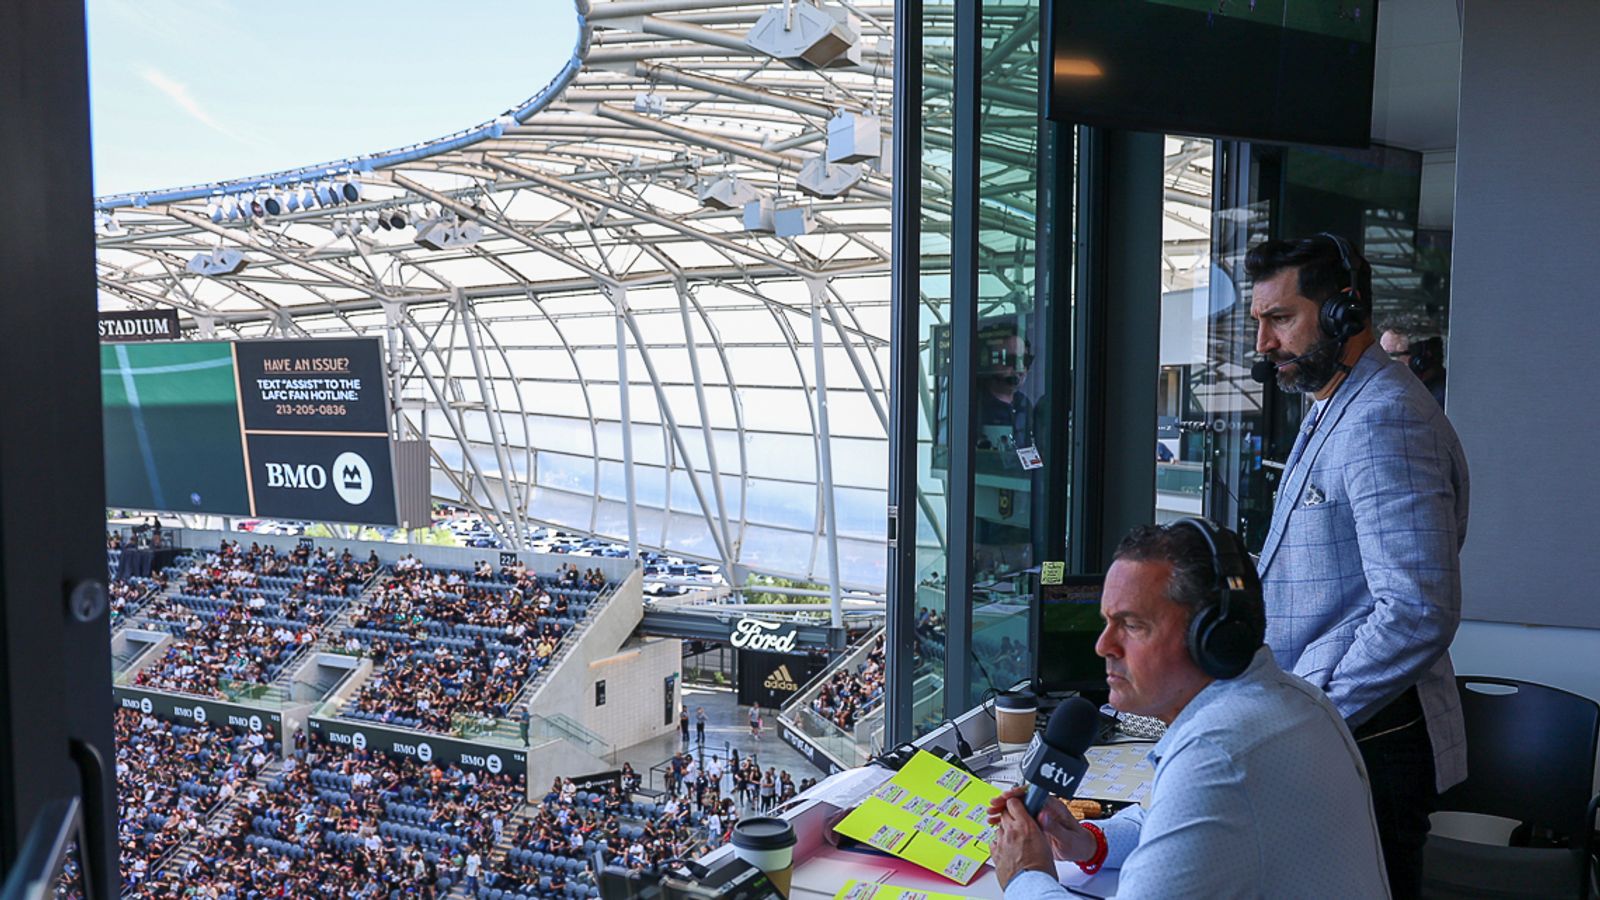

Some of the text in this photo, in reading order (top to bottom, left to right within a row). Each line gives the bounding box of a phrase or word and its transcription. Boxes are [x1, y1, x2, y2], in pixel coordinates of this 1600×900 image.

[98, 318, 170, 336] STADIUM
[263, 357, 350, 372] HAVE AN ISSUE?
[257, 379, 361, 390] TEXT "ASSIST" TO THE
[262, 390, 359, 401] LAFC FAN HOTLINE:
[275, 404, 347, 416] 213-205-0836
[265, 462, 327, 490] BMO
[730, 618, 797, 652] Ford
[763, 680, 798, 691] adidas
[122, 698, 140, 709] BMO
[174, 706, 193, 718] BMO
[228, 715, 249, 727] BMO
[329, 732, 351, 744] BMO
[393, 743, 416, 755] BMO
[461, 754, 486, 767] BMO
[1053, 765, 1075, 787] tv
